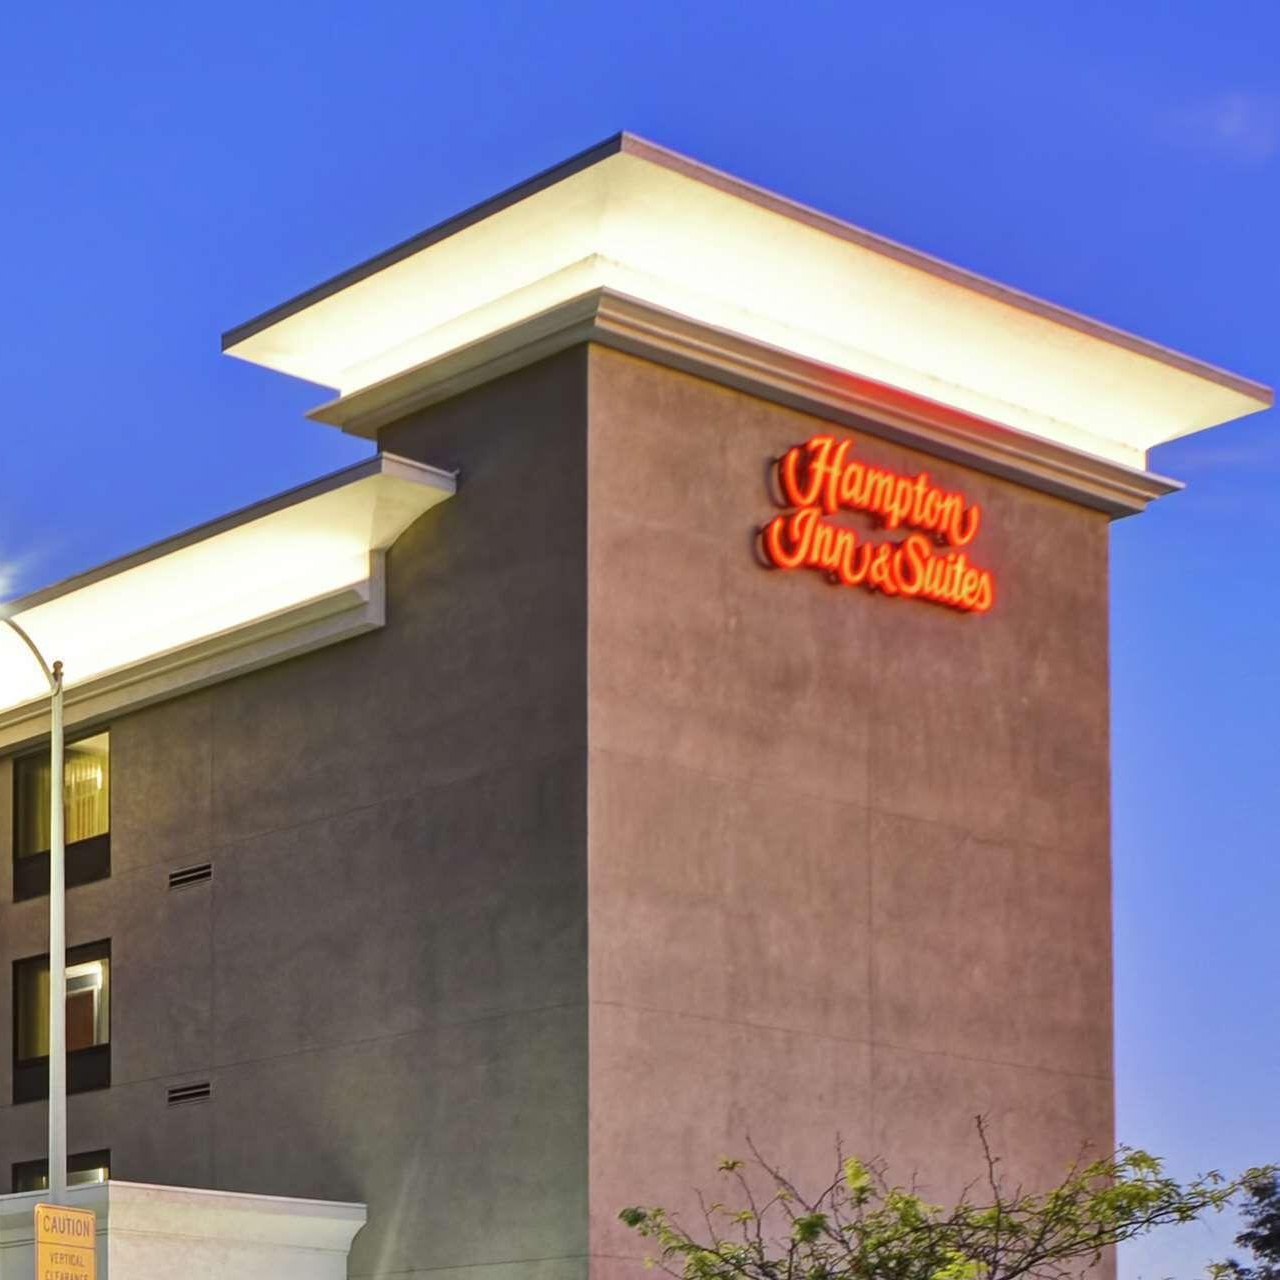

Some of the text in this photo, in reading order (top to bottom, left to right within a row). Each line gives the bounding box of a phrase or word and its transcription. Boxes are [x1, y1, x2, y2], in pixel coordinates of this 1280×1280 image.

[779, 433, 982, 547] Hampton
[765, 507, 997, 614] Inn & Suites
[43, 1215, 90, 1238] CAUTION
[49, 1252, 85, 1268] VERTICAL
